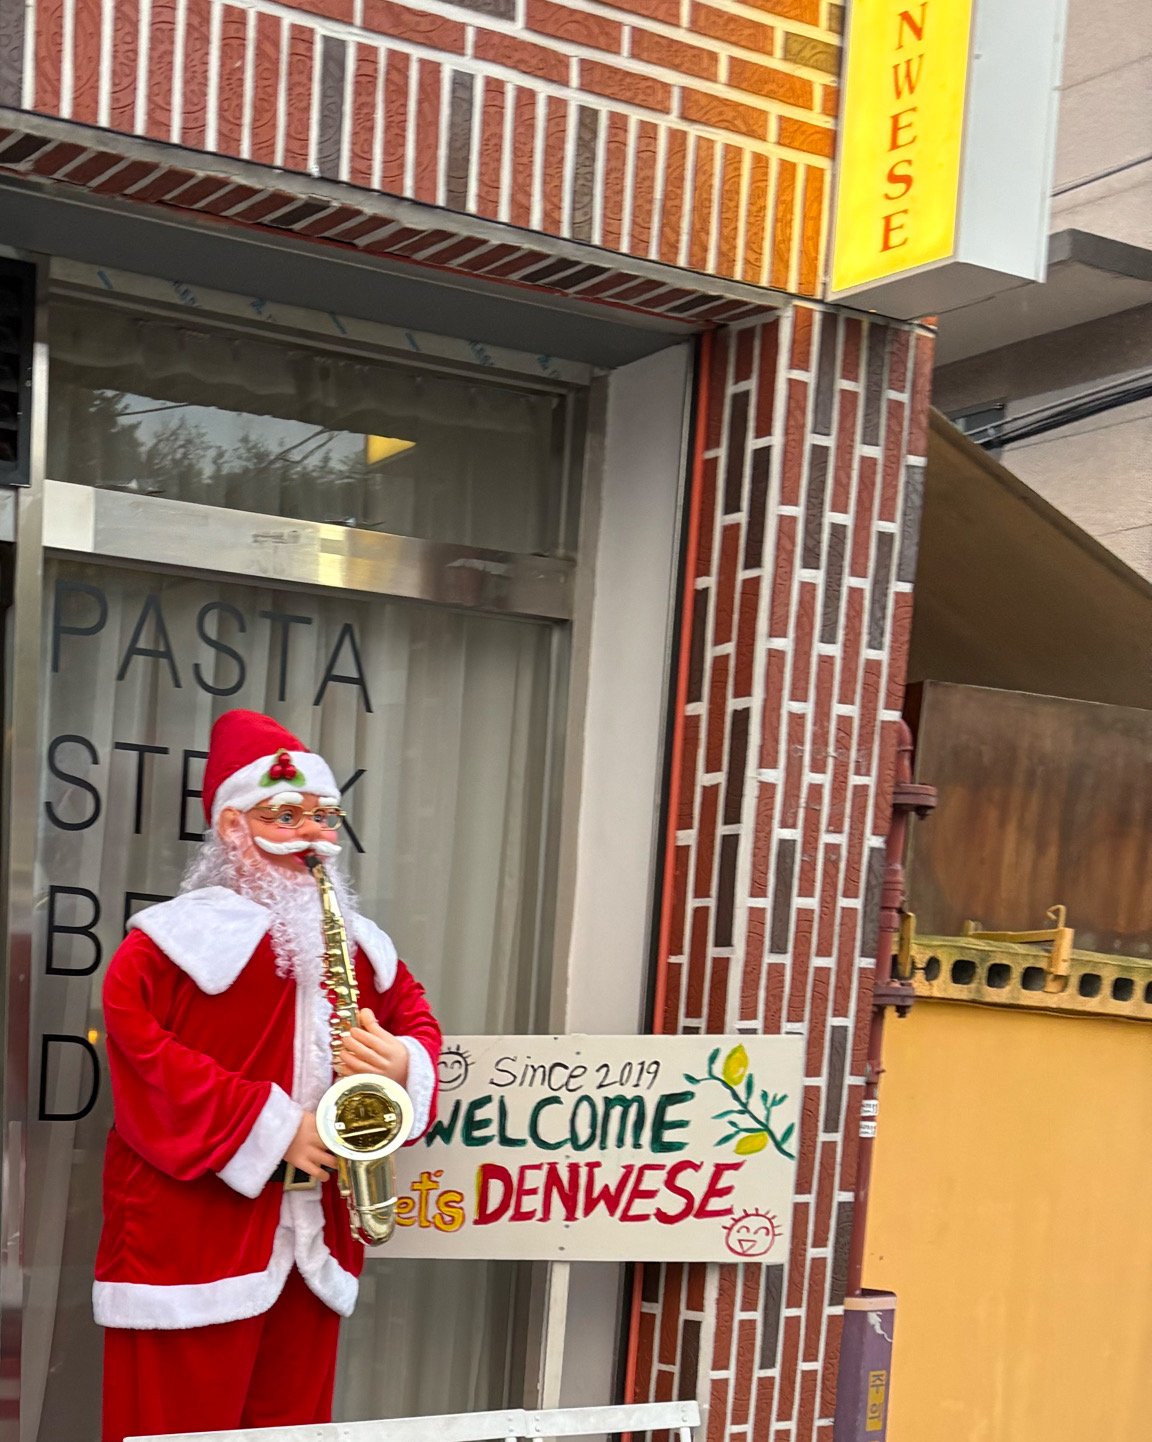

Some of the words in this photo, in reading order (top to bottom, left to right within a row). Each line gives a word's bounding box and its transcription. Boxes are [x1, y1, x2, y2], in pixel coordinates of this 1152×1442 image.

[51, 578, 374, 713] PASTA
[45, 734, 368, 853] STE
[489, 1056, 588, 1092] Since
[595, 1059, 661, 1090] 2019
[425, 1090, 696, 1153] WELCOME
[473, 1160, 747, 1226] DENWESE
